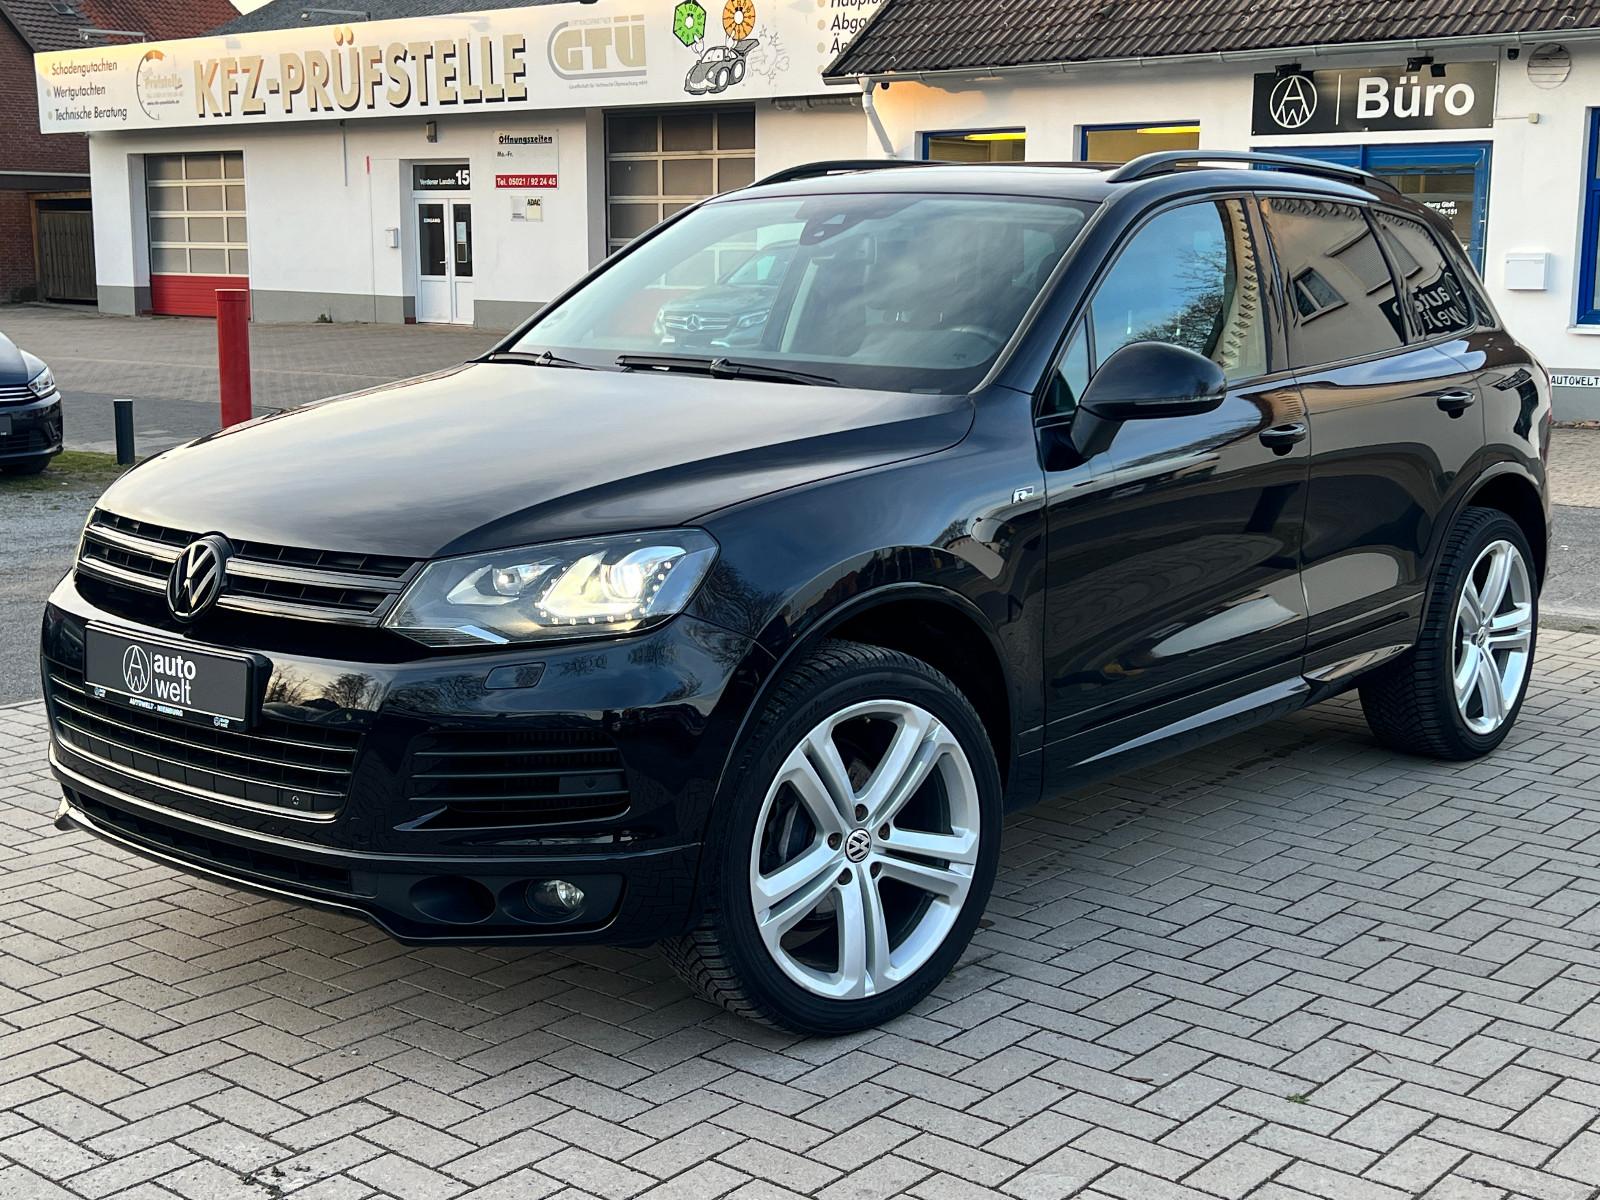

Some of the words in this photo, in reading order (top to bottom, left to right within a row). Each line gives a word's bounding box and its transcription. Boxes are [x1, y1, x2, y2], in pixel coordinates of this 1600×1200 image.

[553, 14, 647, 71] GTÜ
[51, 58, 118, 77] Schadengutachten
[193, 26, 528, 118] KFZ-PRÜFSTELLE
[53, 82, 106, 100] Wertgutachten
[1356, 75, 1475, 119] Büro
[55, 106, 92, 121] Technische
[93, 106, 128, 121] Beratung
[455, 169, 470, 185] 15
[508, 177, 526, 186] 05021
[530, 177, 539, 185] 92
[539, 177, 548, 185] 24
[548, 177, 557, 186] 45
[1551, 375, 1600, 387] AUTOWELT
[153, 653, 197, 680] auto
[154, 678, 192, 705] welt
